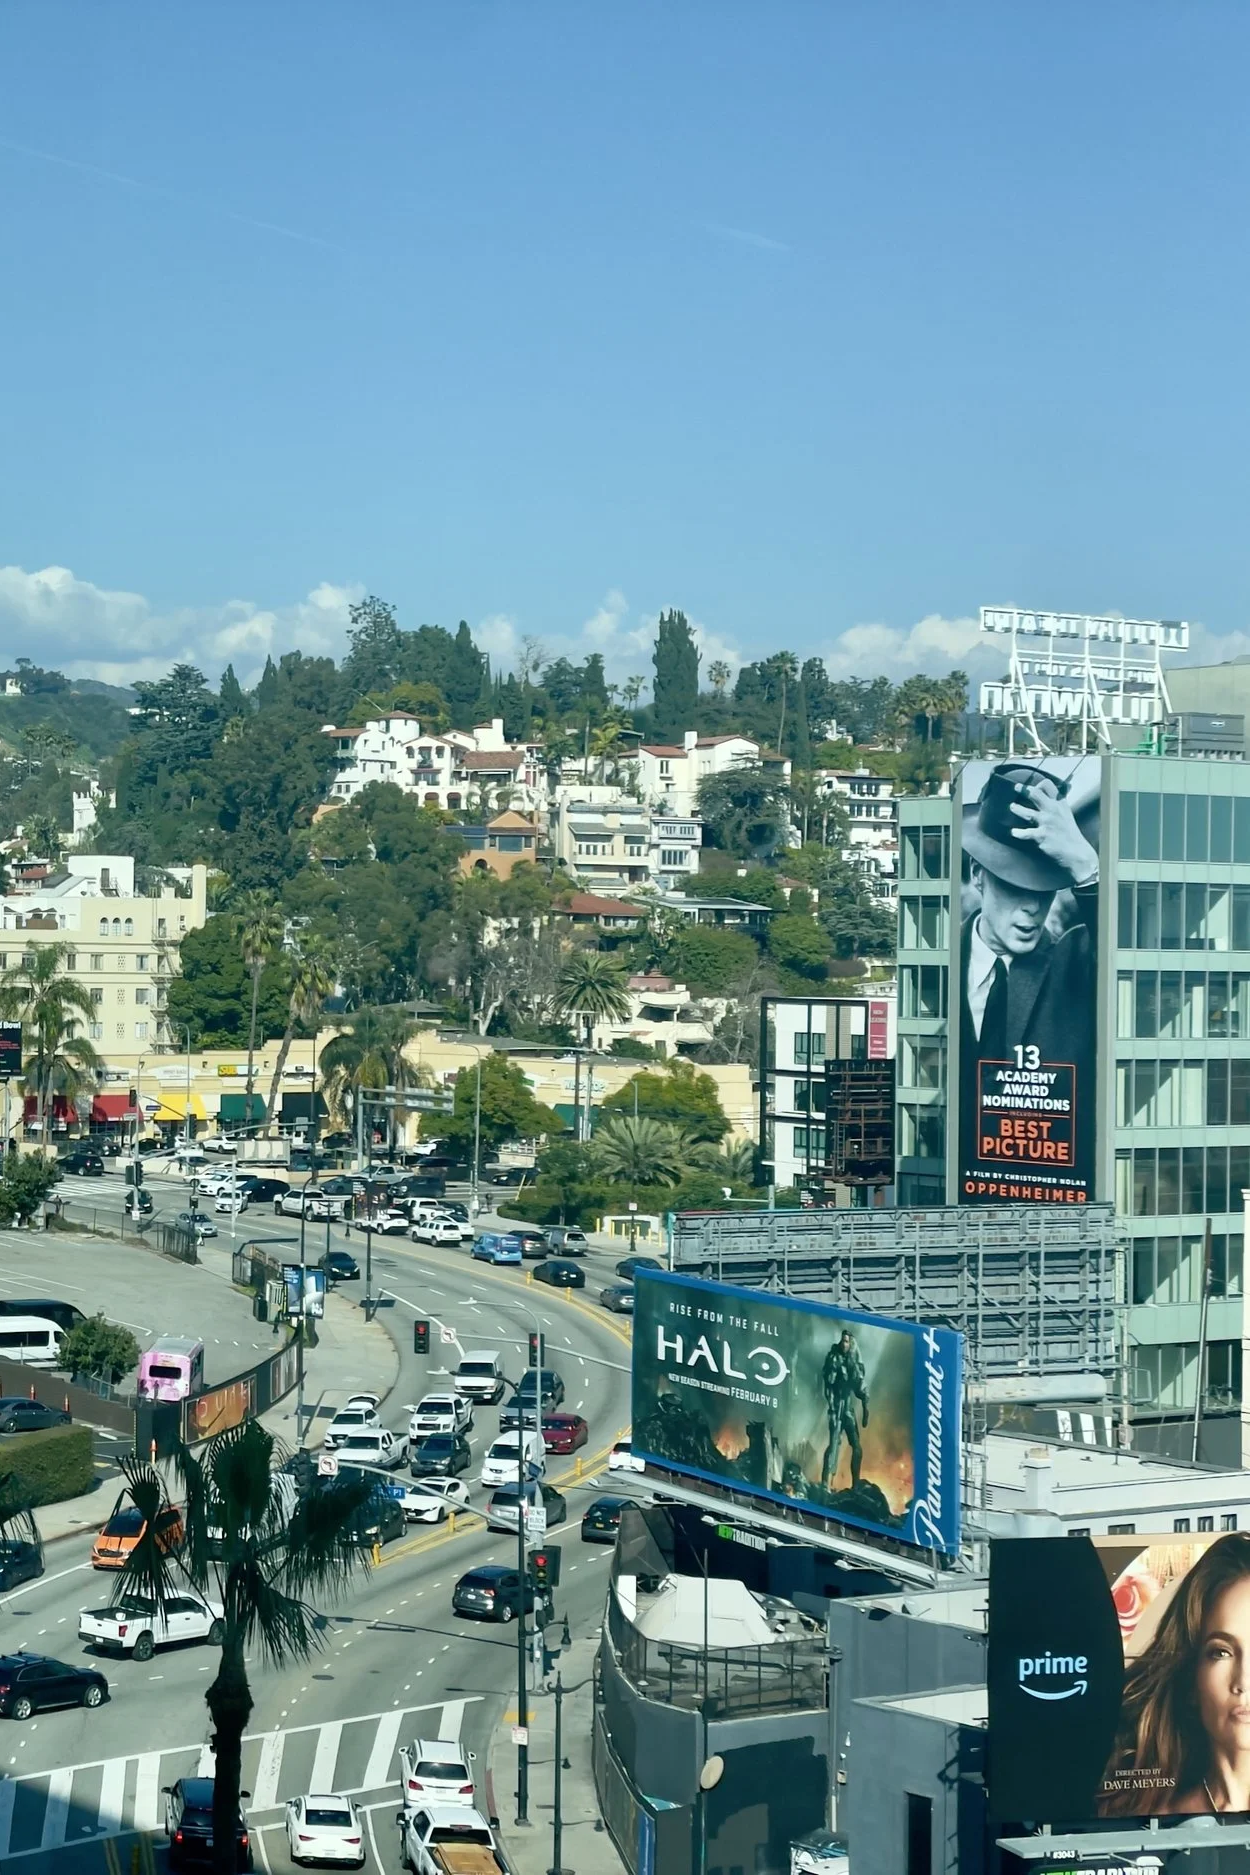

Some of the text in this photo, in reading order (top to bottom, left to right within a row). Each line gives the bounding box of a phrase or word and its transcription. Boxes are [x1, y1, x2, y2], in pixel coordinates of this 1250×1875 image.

[3, 1021, 21, 1029] Bowl
[1013, 1044, 1040, 1070] 13
[996, 1070, 1057, 1084] ACADEMY
[1003, 1083, 1049, 1097] AWARD
[982, 1095, 1070, 1111] NOMINATIONS
[1000, 1118, 1052, 1139] BEST
[982, 1136, 1069, 1160] PICTURE
[1005, 1173, 1057, 1184] CHRISTOPHER
[1059, 1178, 1087, 1187] NOLAN
[965, 1181, 1087, 1203] OPPENHEIMER
[669, 1302, 779, 1337] RISE FROM THE FALL
[657, 1325, 790, 1386] HALO
[668, 1372, 680, 1381] NEW
[680, 1374, 701, 1387] SEASON
[700, 1380, 731, 1396] STREAMING
[731, 1387, 771, 1406] FEBRUARY
[1019, 1651, 1088, 1681] prime
[1115, 1769, 1151, 1777] DIRECTED
[1104, 1778, 1176, 1790] DAVE MEYERS
